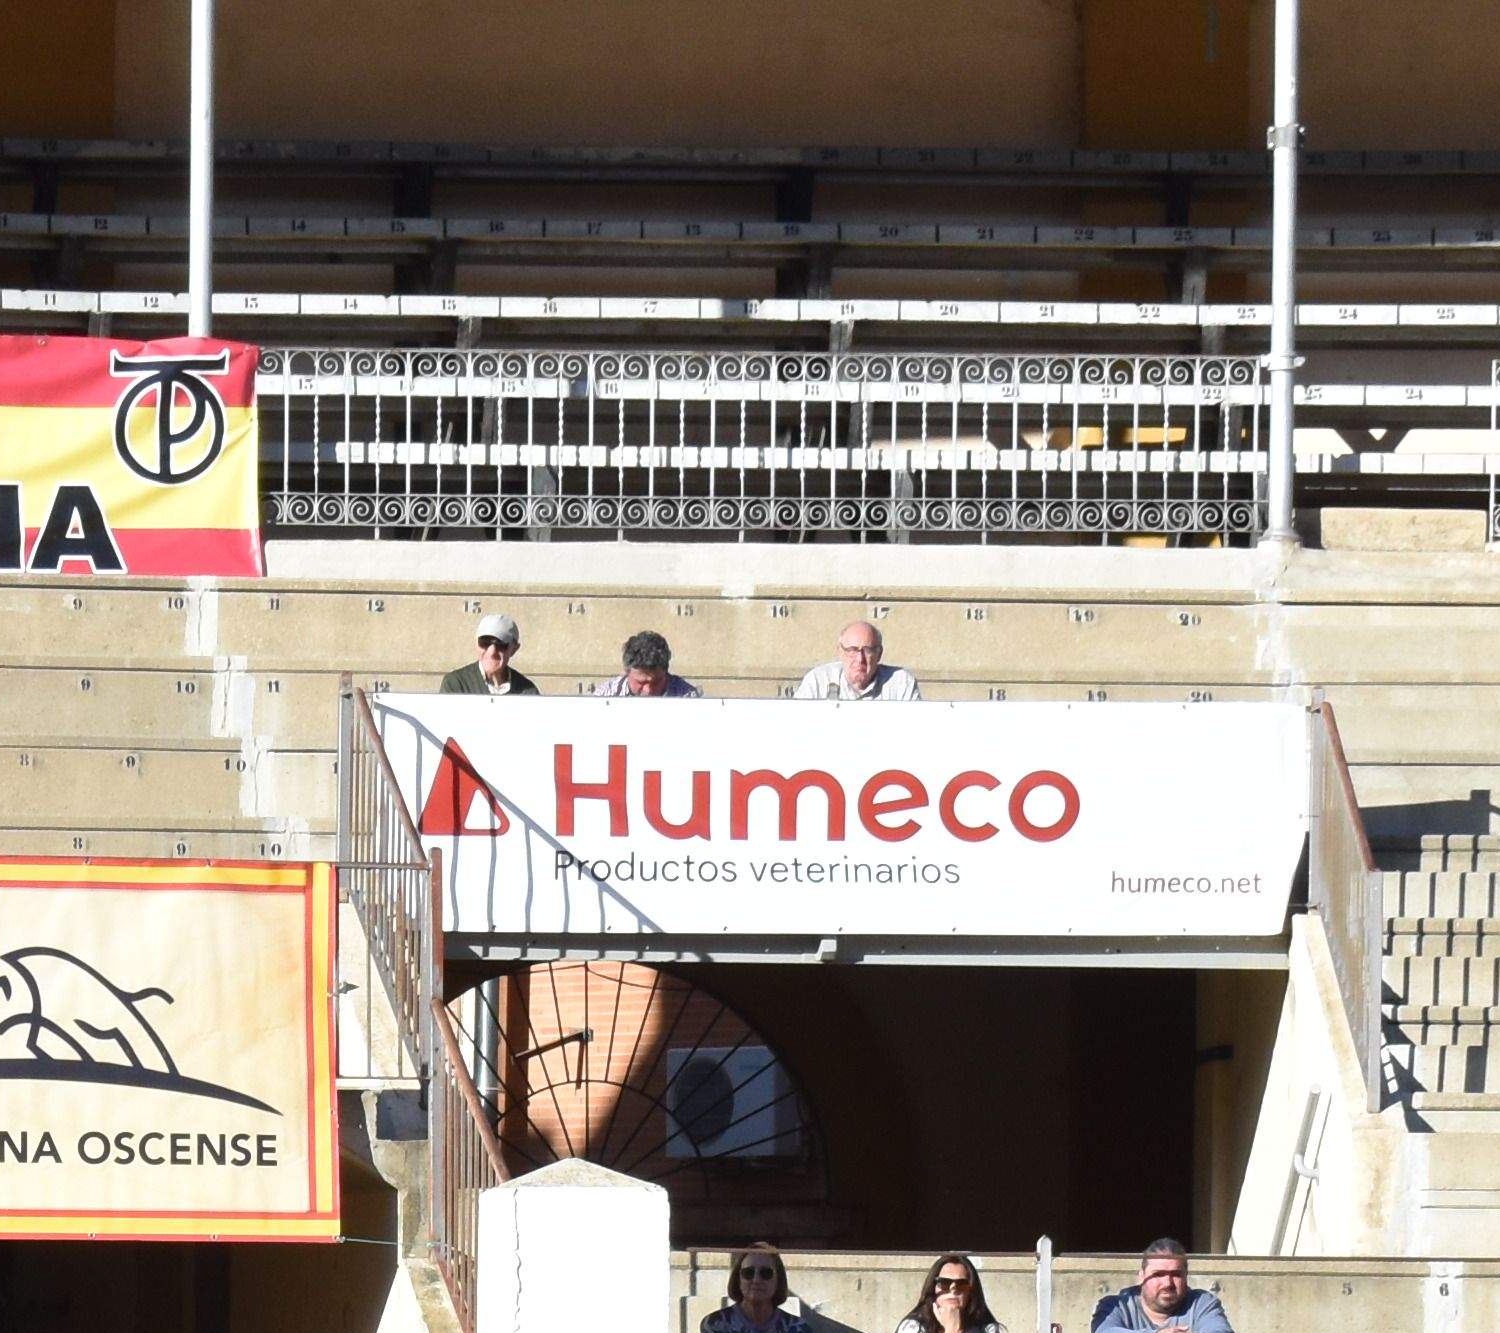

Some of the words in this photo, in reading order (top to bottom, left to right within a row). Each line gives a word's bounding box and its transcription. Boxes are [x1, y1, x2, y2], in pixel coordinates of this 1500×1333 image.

[72, 598, 83, 610] 9
[168, 596, 184, 610] 10
[368, 599, 385, 613] 12
[567, 602, 586, 615] 14
[772, 605, 789, 618] 16
[873, 606, 890, 619] 17
[966, 608, 984, 621] 18
[1179, 613, 1202, 627] 20
[80, 678, 91, 691] 9
[177, 680, 196, 694] 10
[268, 680, 280, 693] 11
[578, 682, 596, 695] 14
[125, 755, 136, 768] 9
[224, 757, 247, 772] 10
[553, 743, 1081, 843] Humeco
[72, 836, 83, 850] 8
[176, 843, 187, 856] 9
[260, 843, 282, 856] 10
[554, 851, 738, 884] Productos
[752, 855, 961, 886] veterinarios
[1110, 870, 1263, 894] humeco.net
[76, 1131, 279, 1168] OSCENSE
[1439, 1282, 1450, 1297] 6
